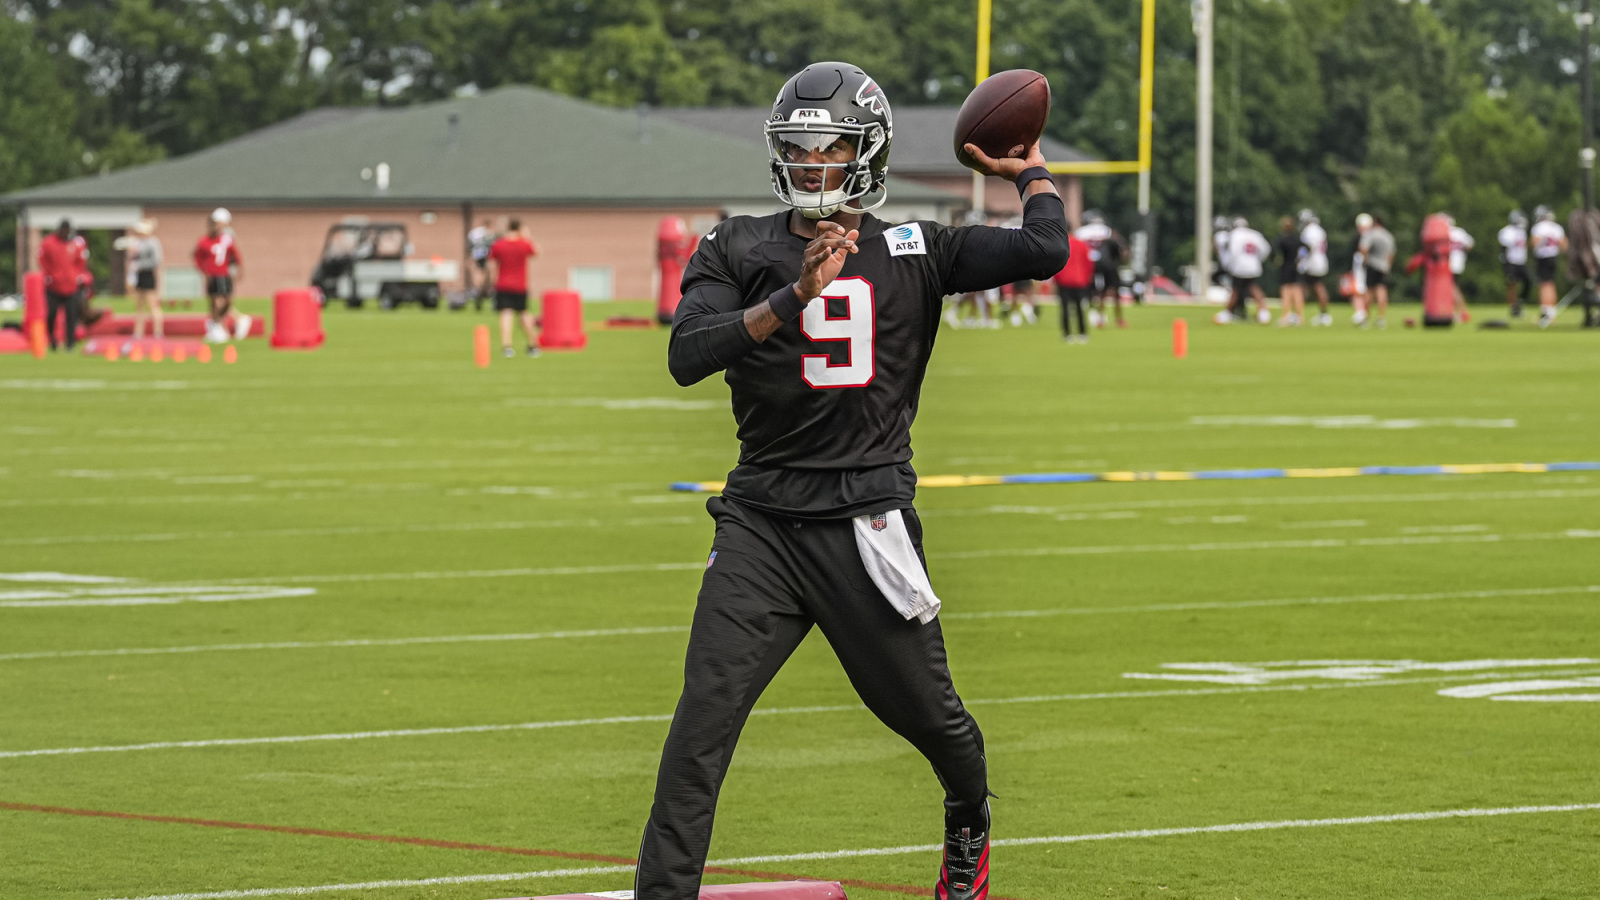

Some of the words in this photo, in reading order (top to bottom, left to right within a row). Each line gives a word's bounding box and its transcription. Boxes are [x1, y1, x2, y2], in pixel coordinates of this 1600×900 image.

[798, 110, 820, 119] ATL
[895, 241, 919, 251] AT&T
[800, 275, 876, 390] 9
